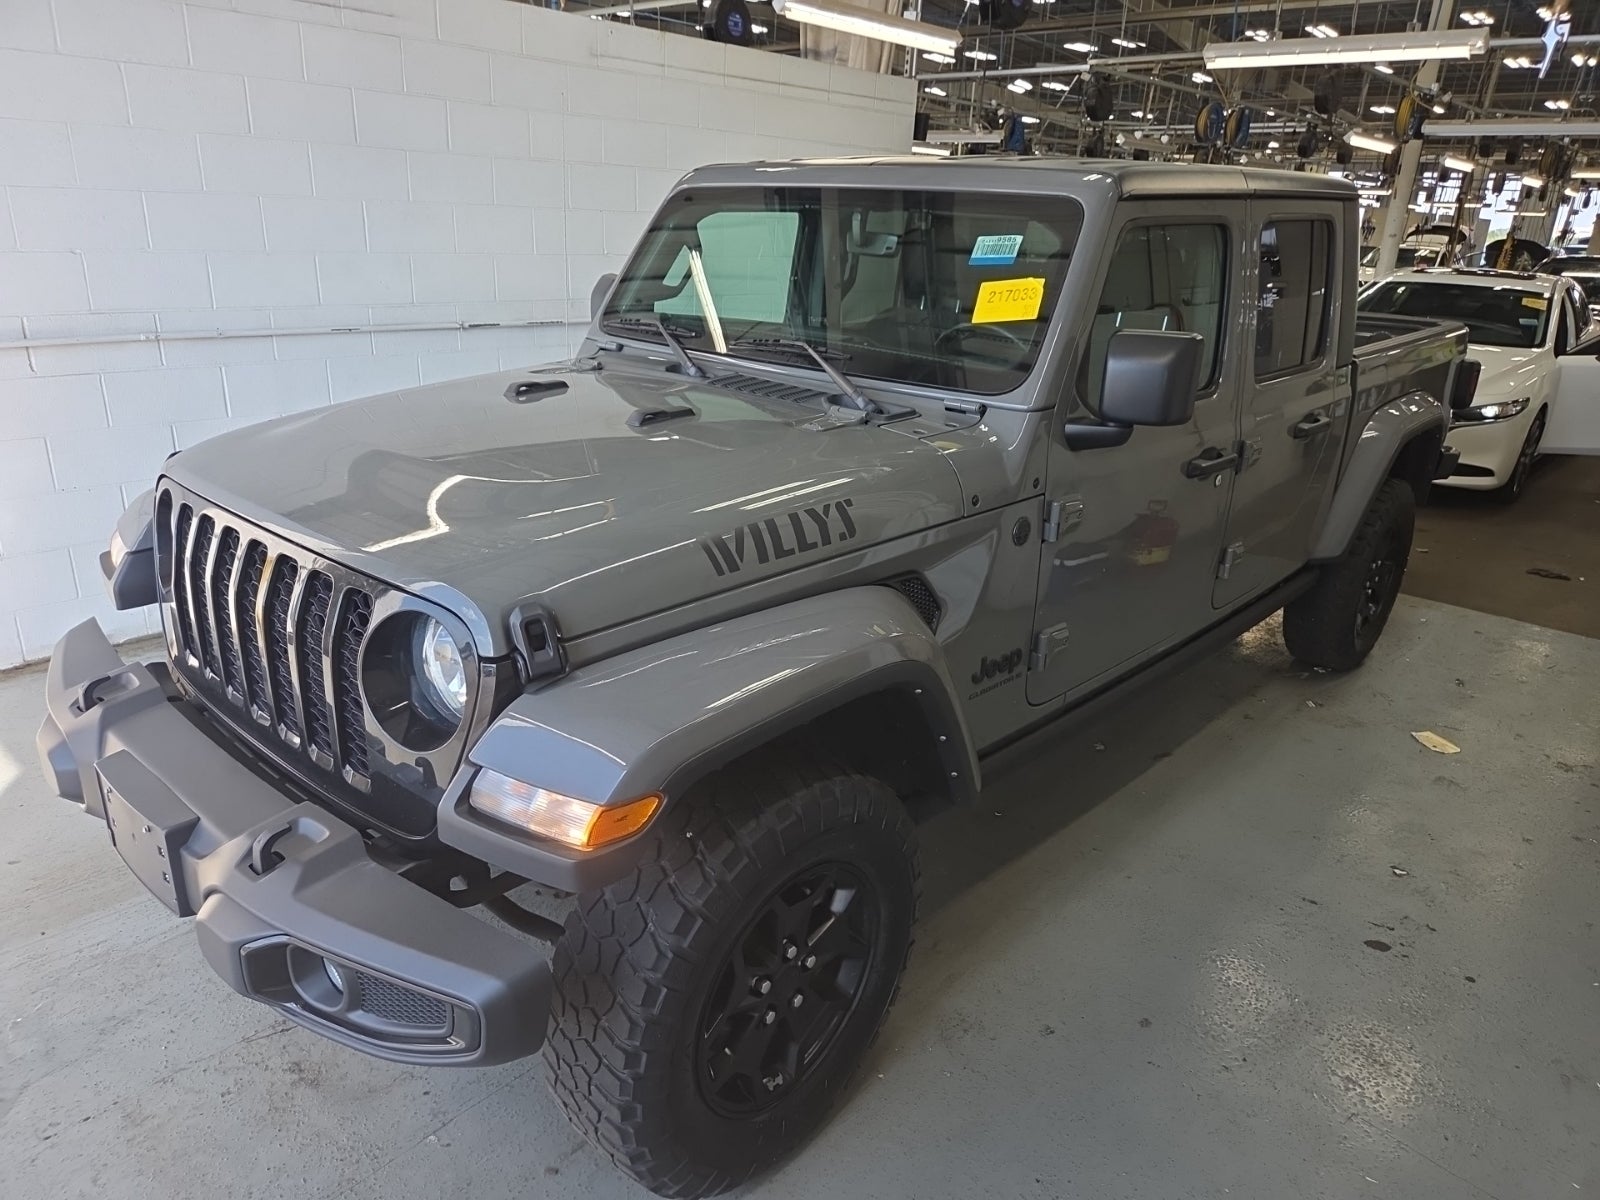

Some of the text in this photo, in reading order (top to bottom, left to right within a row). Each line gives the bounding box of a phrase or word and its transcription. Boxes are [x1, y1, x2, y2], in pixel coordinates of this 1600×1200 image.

[987, 287, 1038, 304] 217033
[699, 498, 857, 577] WILLYS
[971, 648, 1022, 685] Jeep
